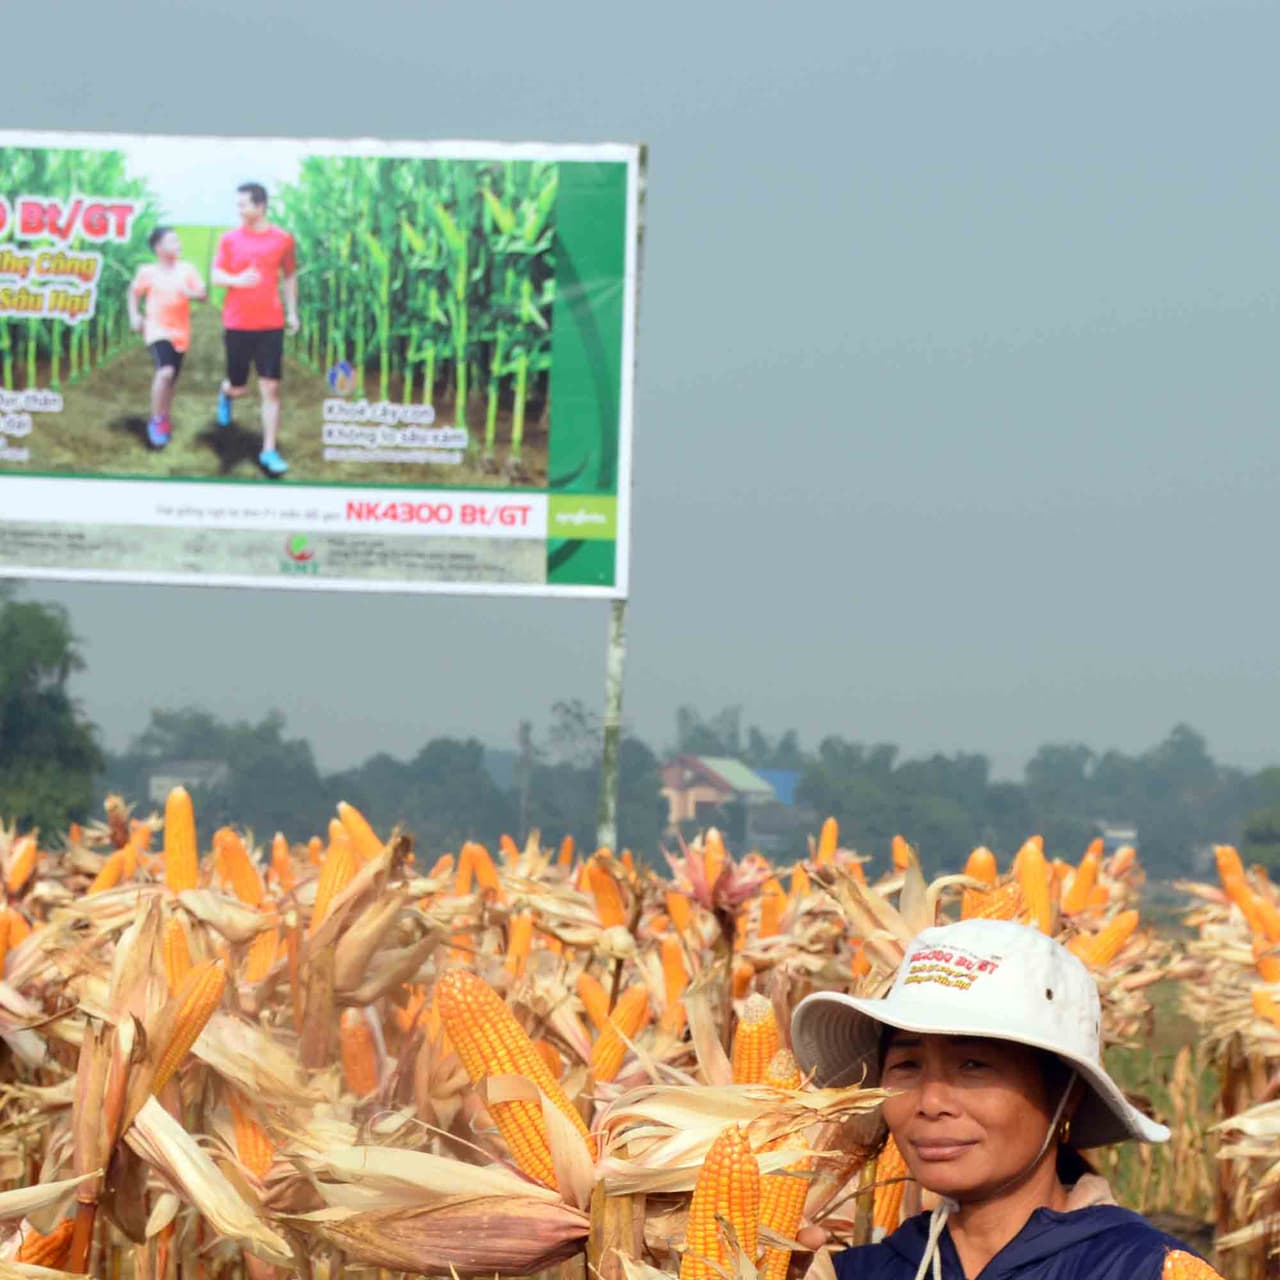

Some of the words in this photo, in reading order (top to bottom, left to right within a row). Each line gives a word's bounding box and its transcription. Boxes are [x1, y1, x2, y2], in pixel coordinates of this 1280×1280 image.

[20, 199, 134, 240] Bt/GT
[35, 250, 97, 282] Công
[345, 501, 453, 525] NK4300
[460, 504, 531, 527] Bt/GT
